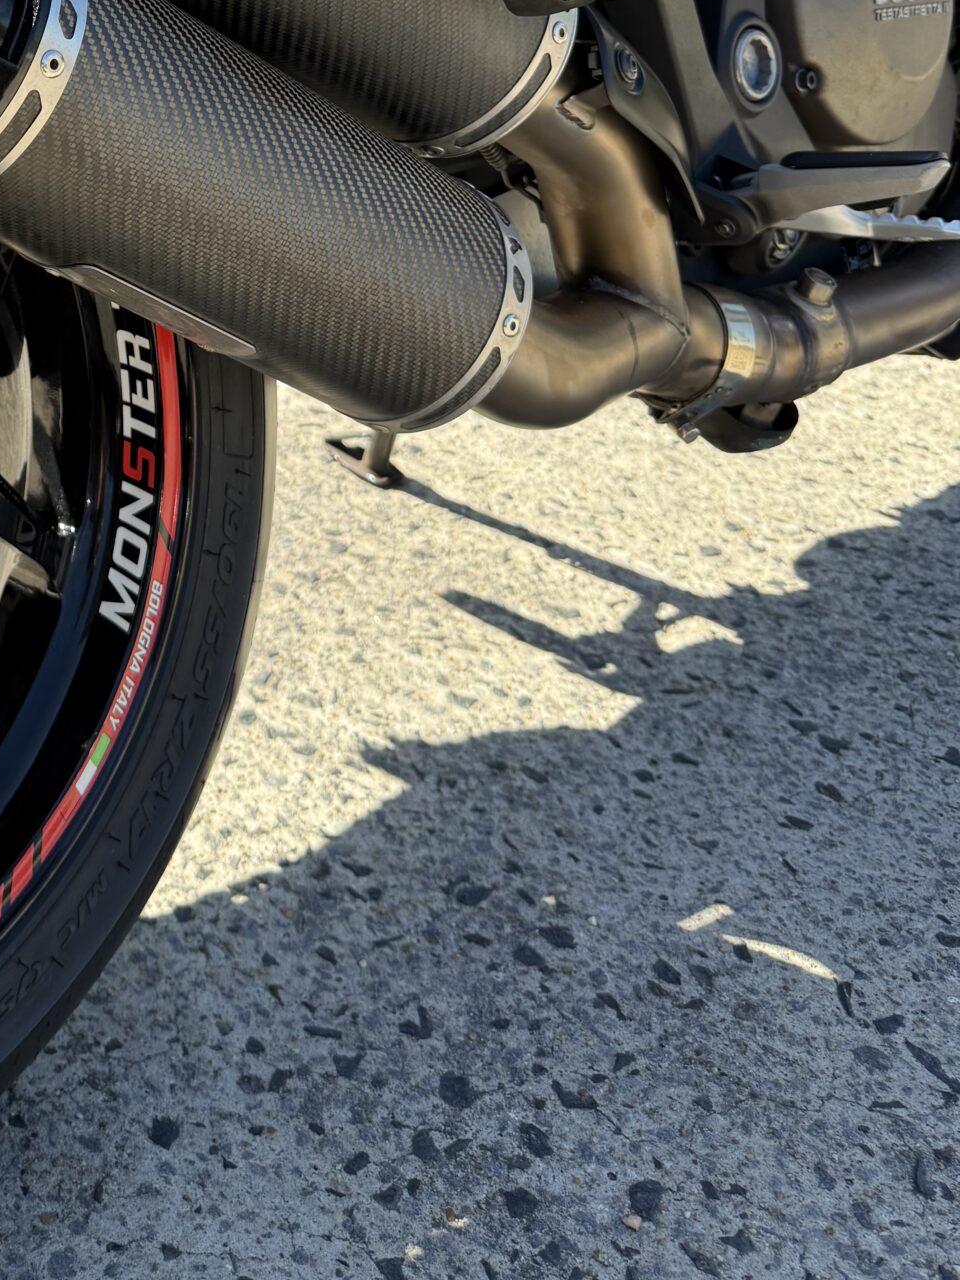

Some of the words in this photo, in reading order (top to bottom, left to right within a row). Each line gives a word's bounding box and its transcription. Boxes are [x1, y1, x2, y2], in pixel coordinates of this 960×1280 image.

[98, 329, 158, 634] MONSTER
[129, 579, 164, 673] BOLOGNA
[192, 482, 243, 703] 190/55
[108, 675, 136, 731] ITALY
